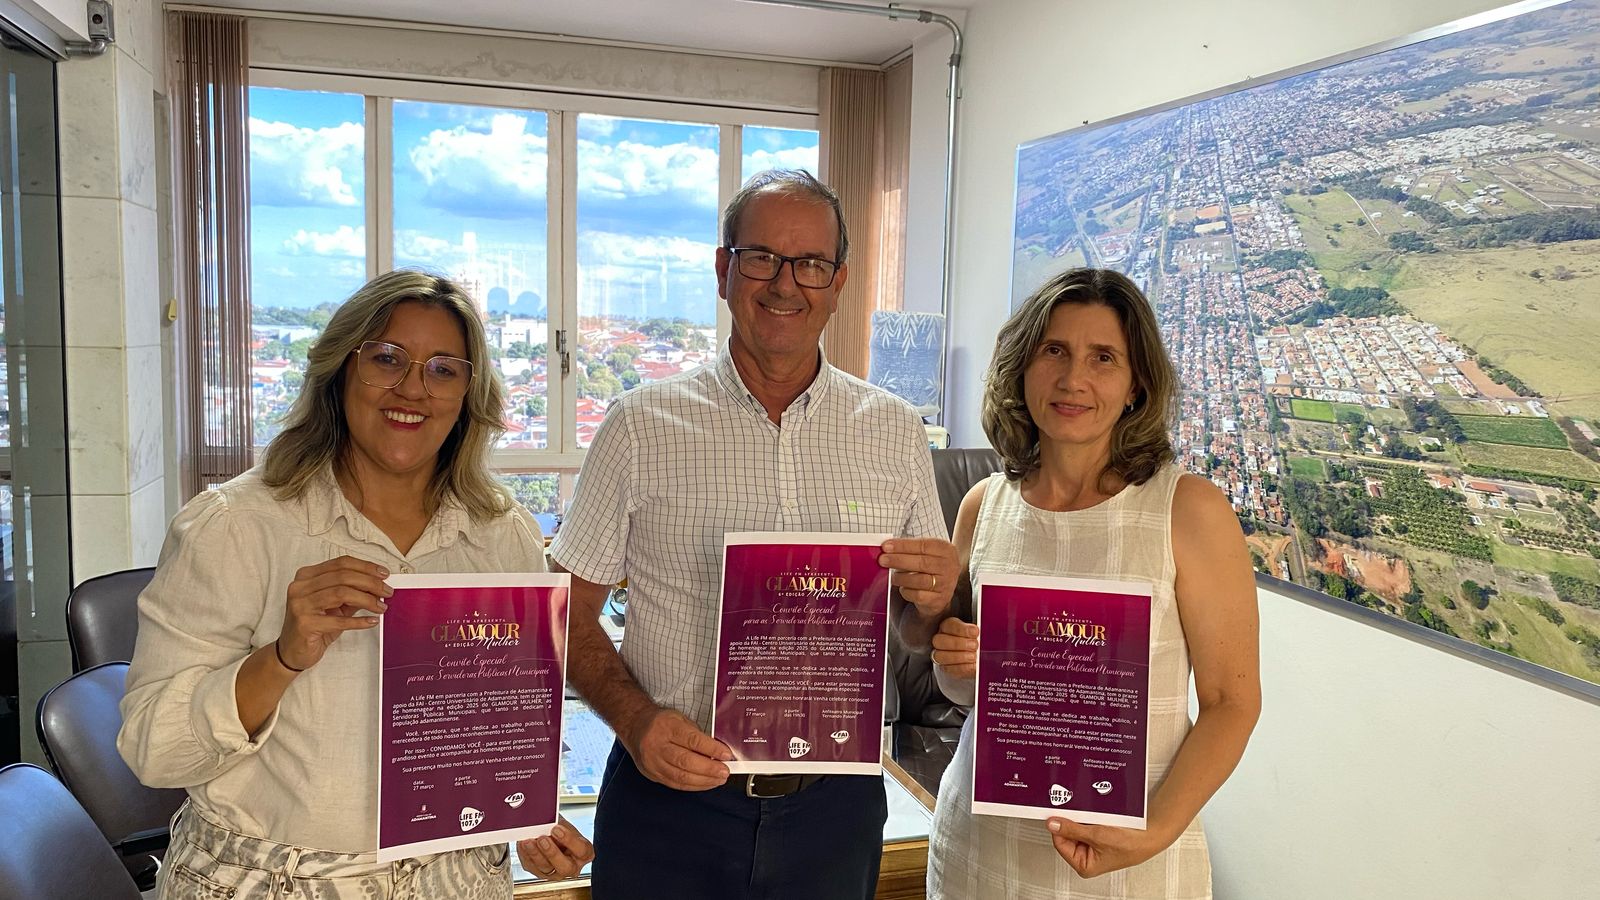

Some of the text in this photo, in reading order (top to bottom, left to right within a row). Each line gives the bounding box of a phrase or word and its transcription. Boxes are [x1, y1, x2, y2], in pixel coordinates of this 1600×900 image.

[766, 577, 848, 591] GLAMOUR
[802, 588, 847, 600] Mulher
[772, 603, 834, 615] Convite Especial
[743, 619, 760, 627] para
[771, 614, 806, 624] Servidoras
[807, 615, 836, 625] Públicas
[835, 615, 875, 628] Municipais
[431, 623, 521, 642] GLAMOUR
[1023, 620, 1107, 640] GLAMOUR
[471, 635, 521, 651] Mulher
[1060, 633, 1107, 649] Mulher
[439, 652, 508, 669] Convite Especial
[1030, 647, 1095, 664] Convite Especial
[406, 675, 425, 686] para
[438, 668, 476, 681] Servidoras
[478, 666, 508, 679] Públicas
[508, 664, 550, 679] Municipais
[1001, 660, 1018, 669] para
[1030, 659, 1065, 671] Servidoras
[1067, 662, 1096, 674] Públicas
[1095, 664, 1136, 679] Municipais
[488, 695, 519, 703] Adamantina,
[402, 706, 434, 715] homenagear
[449, 709, 477, 717] Municipais,
[393, 716, 460, 727] população adamantinense.
[422, 729, 447, 737] servidora,
[460, 730, 500, 738] reconhecimento
[392, 754, 417, 763] grandioso
[441, 749, 472, 758] acompanhar
[480, 745, 512, 754] homenagens
[430, 744, 466, 752] CONVIDAMOS
[461, 819, 479, 828] 107,9
